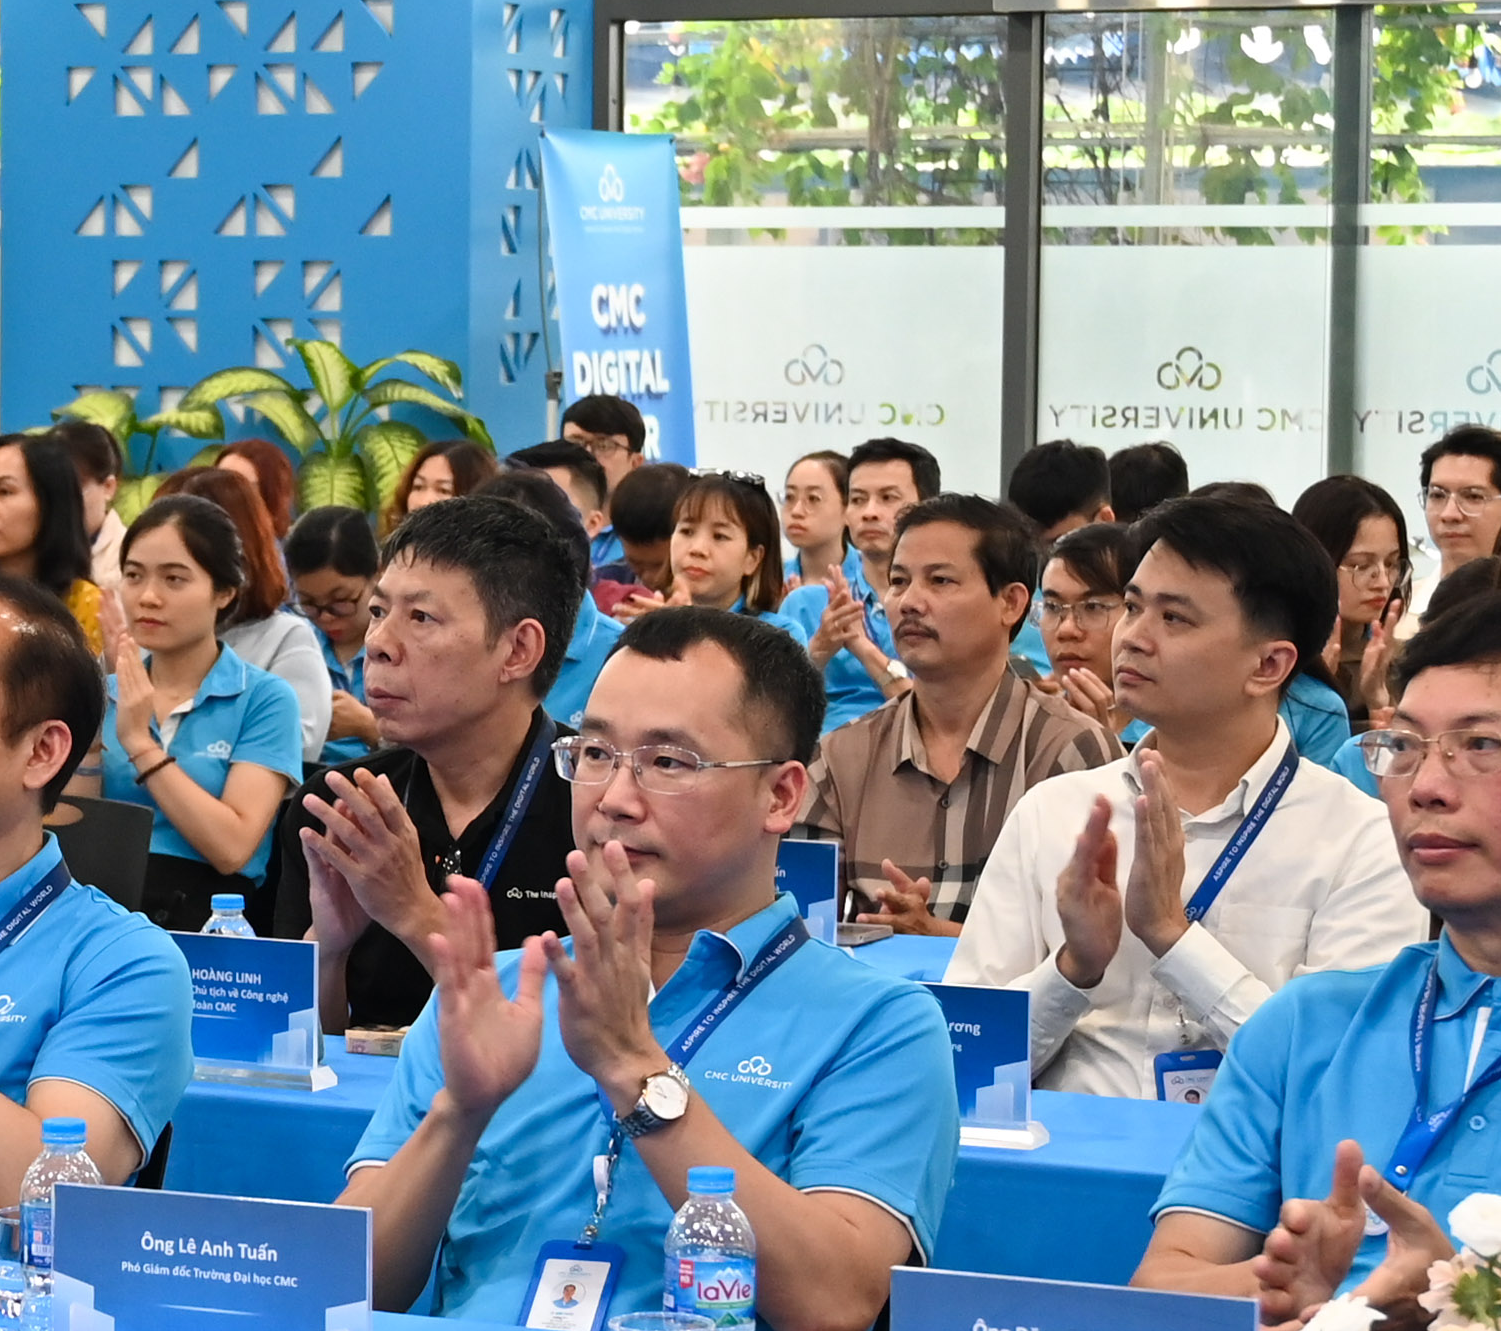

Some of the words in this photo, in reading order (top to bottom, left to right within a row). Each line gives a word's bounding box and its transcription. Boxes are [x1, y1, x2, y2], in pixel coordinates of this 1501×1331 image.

[591, 283, 646, 330] CMC
[572, 349, 671, 398] DIGITAL
[7, 908, 32, 932] DIGITAL
[30, 884, 54, 908] WORLD
[192, 966, 234, 983] HOÀNG
[235, 972, 262, 985] LINH
[209, 986, 226, 999] tịch
[227, 988, 239, 999] về
[240, 989, 265, 1003] Công
[265, 991, 289, 1005] nghệ
[214, 1001, 237, 1013] CMC
[681, 1025, 706, 1053] ASPIRE
[702, 1014, 715, 1026] TO
[713, 988, 740, 1016] INSPIRE
[735, 976, 751, 991] THE
[749, 954, 777, 979] DIGITAL
[772, 933, 796, 957] WORLD
[705, 1070, 729, 1083] CMC
[141, 1231, 175, 1256] Ông
[178, 1237, 197, 1255] Lê
[200, 1239, 234, 1258] Anh
[238, 1242, 278, 1262] Tuấn
[121, 1261, 142, 1273] Phó
[143, 1262, 170, 1276] Giám
[172, 1264, 192, 1278] đốc
[193, 1267, 232, 1284] Trường
[233, 1271, 252, 1285] Đại
[253, 1272, 272, 1287] học
[274, 1275, 299, 1288] CMC
